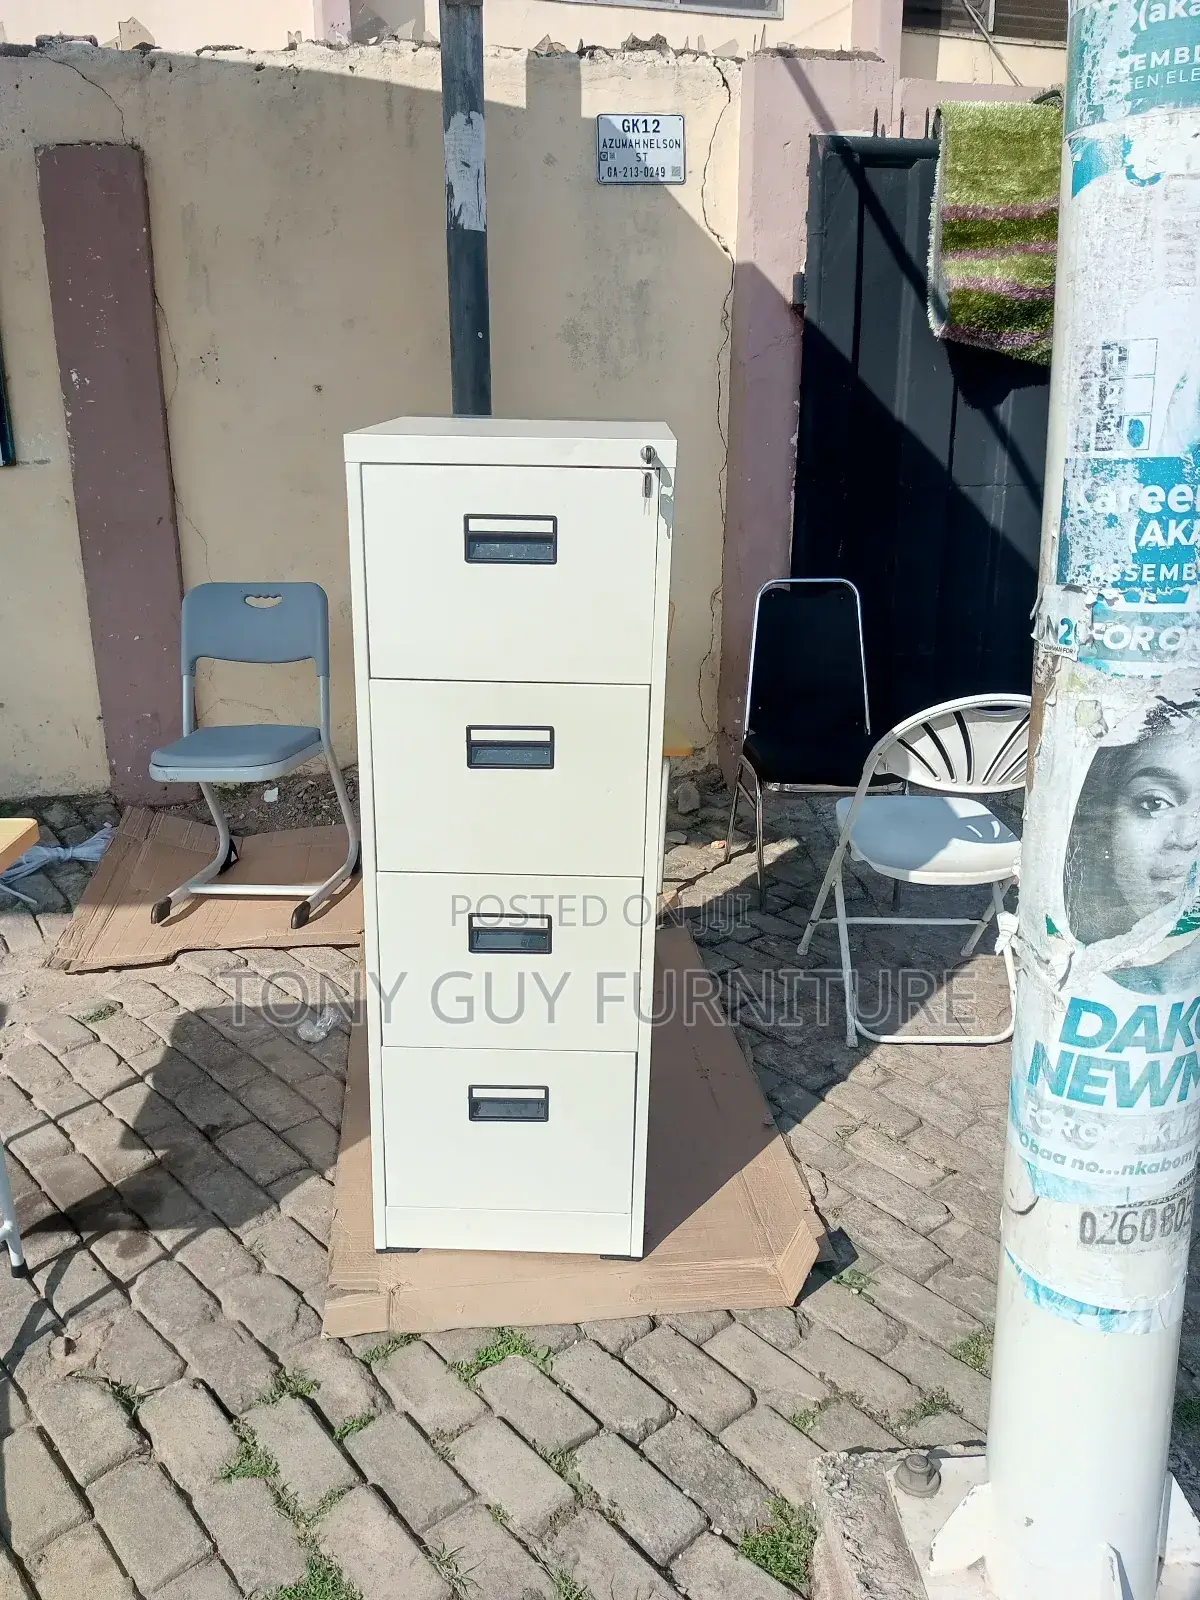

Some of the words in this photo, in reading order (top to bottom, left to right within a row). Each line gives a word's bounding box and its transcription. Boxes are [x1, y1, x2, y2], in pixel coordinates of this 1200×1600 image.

[622, 118, 661, 133] GK12
[602, 138, 641, 149] AZUMAH
[642, 138, 681, 149] NELSON
[635, 152, 648, 162] ST
[607, 166, 666, 178] GA-213-0249
